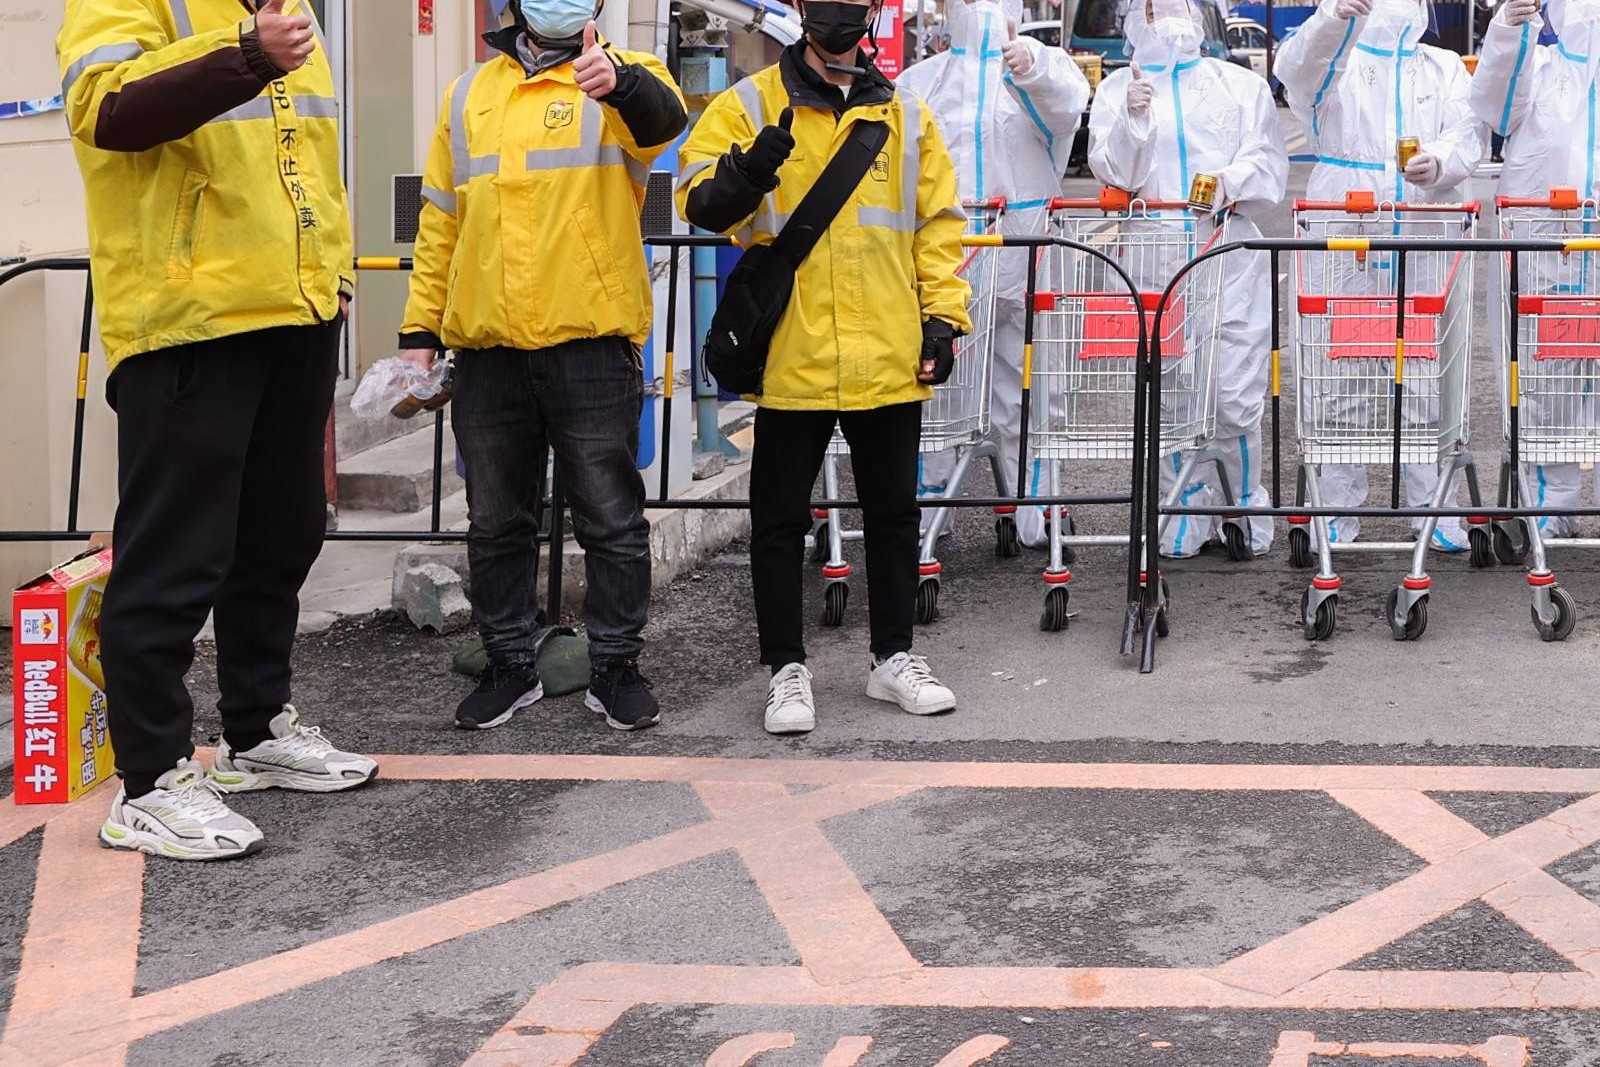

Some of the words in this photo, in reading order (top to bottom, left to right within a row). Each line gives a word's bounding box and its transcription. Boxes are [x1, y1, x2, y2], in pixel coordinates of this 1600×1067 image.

[280, 128, 317, 228] 不止外卖
[23, 659, 59, 725] RedBull
[23, 726, 59, 793] 红牛
